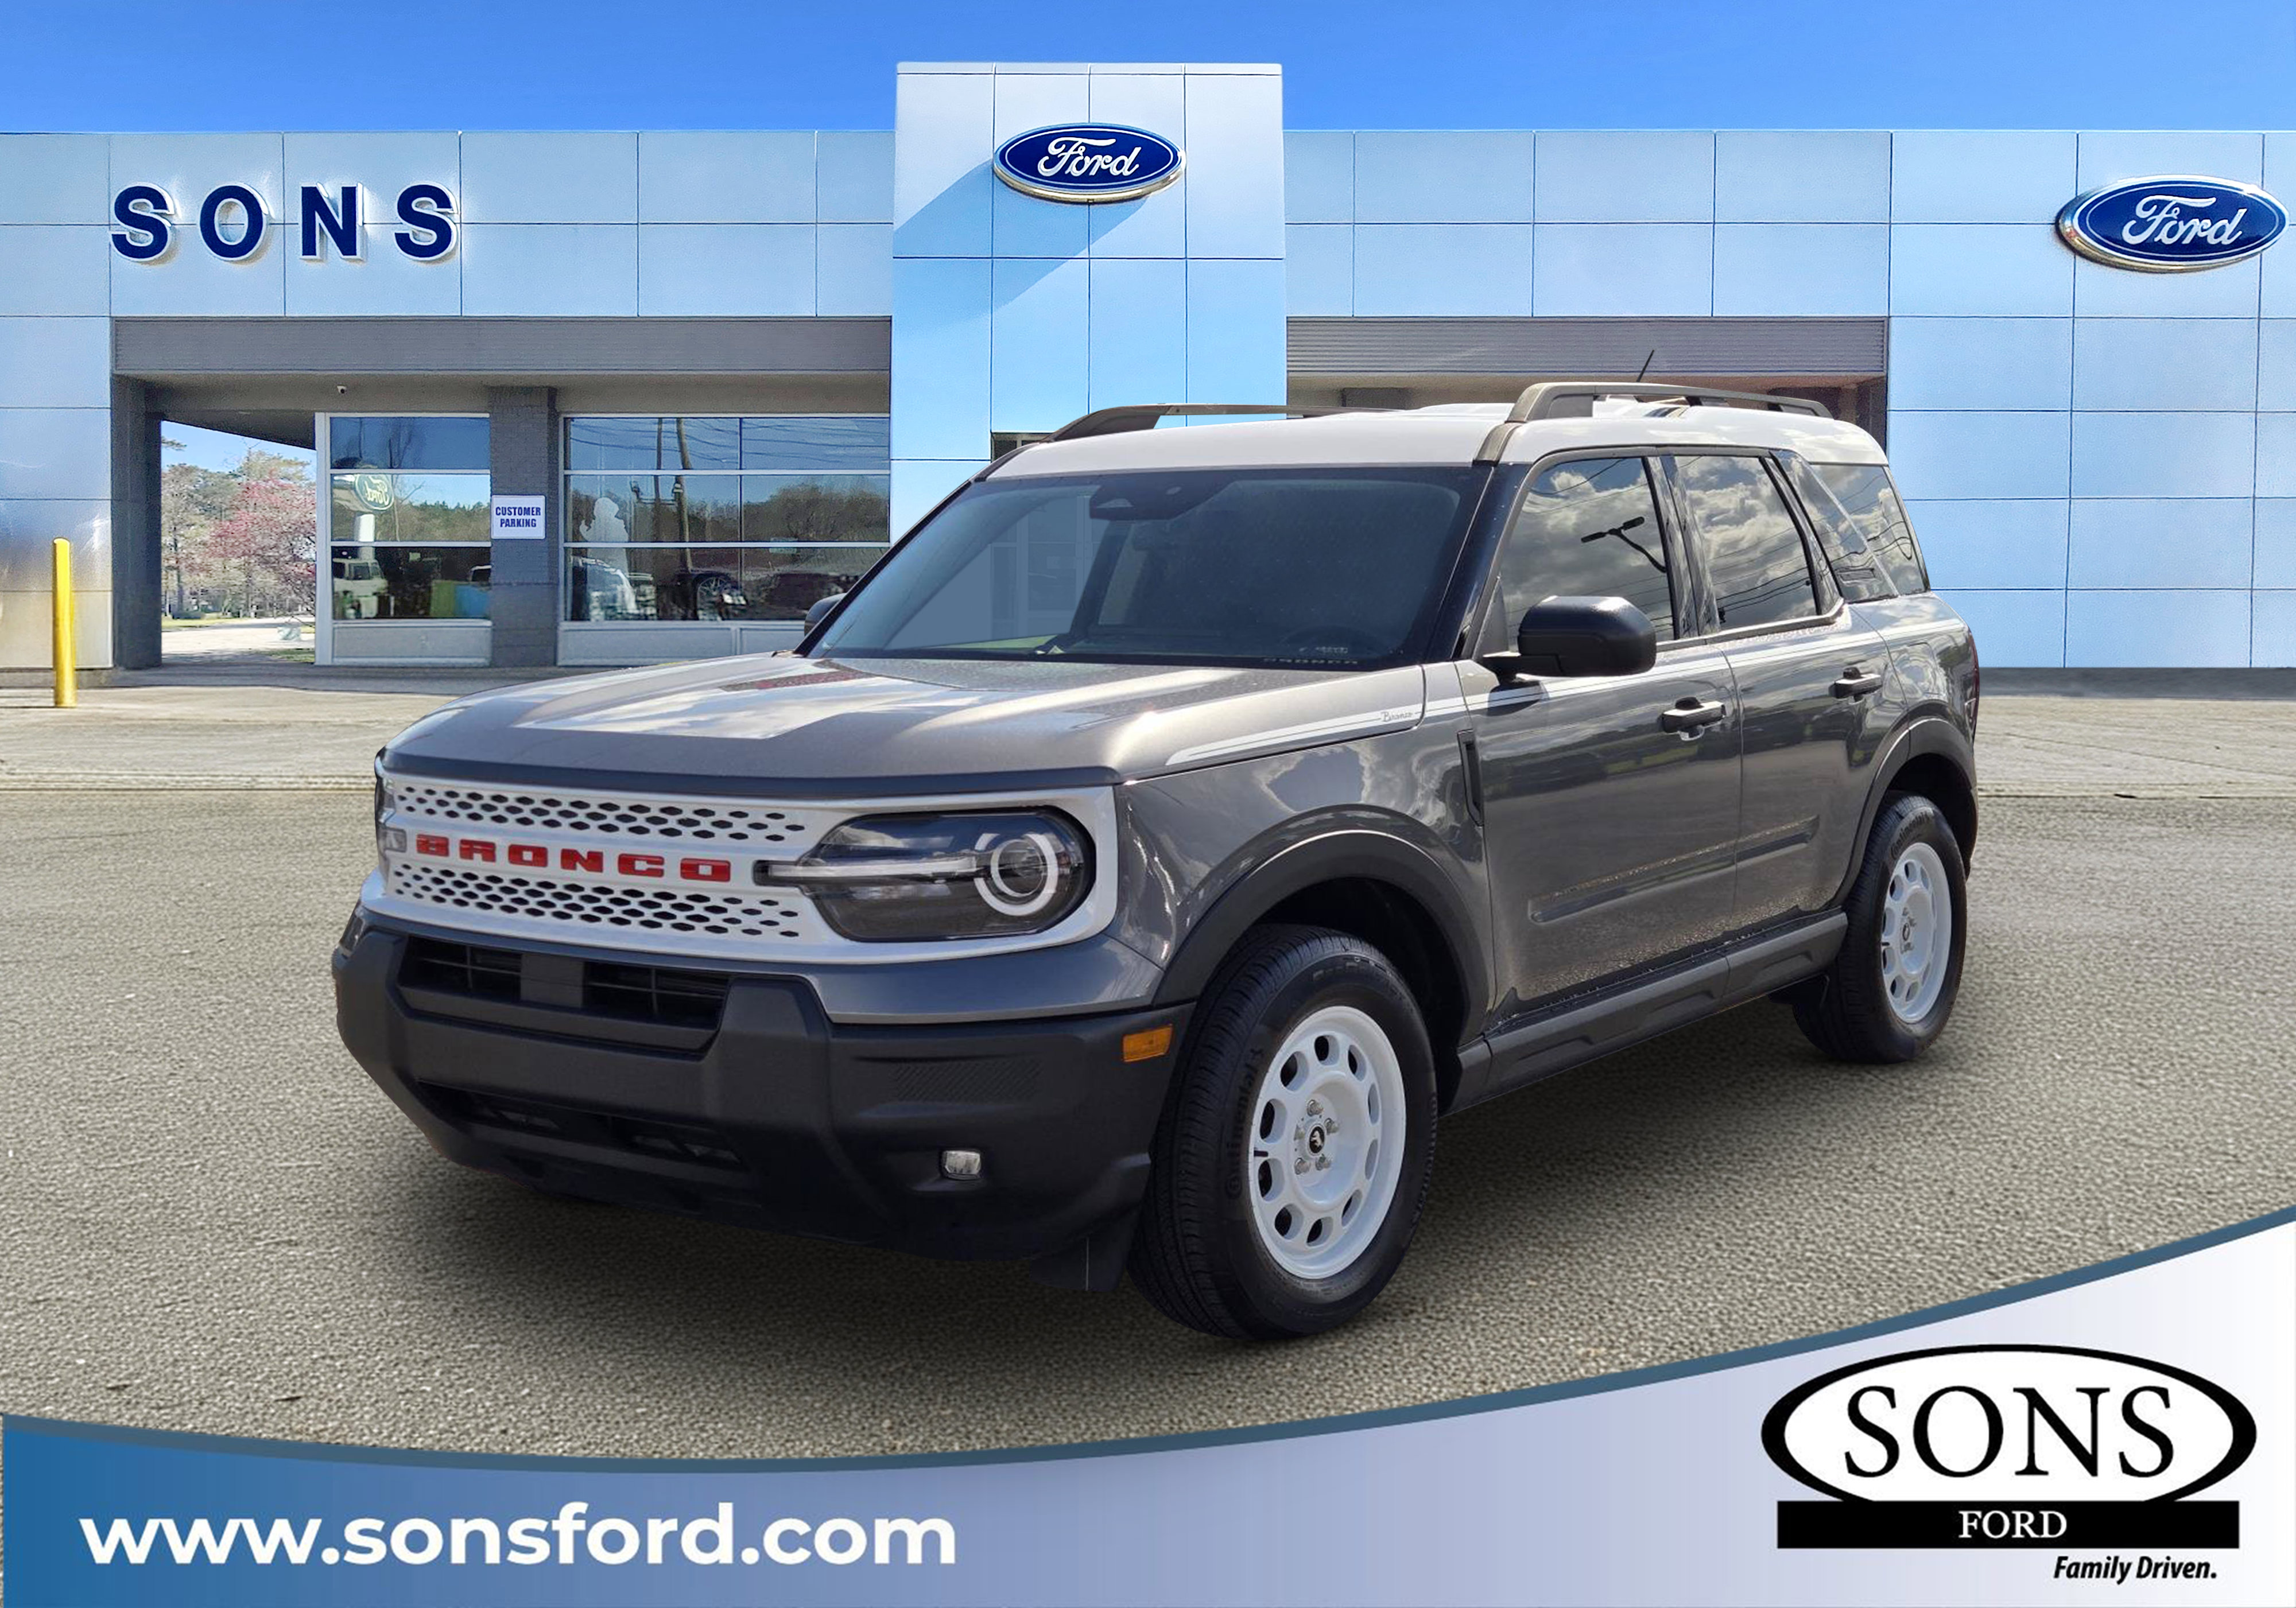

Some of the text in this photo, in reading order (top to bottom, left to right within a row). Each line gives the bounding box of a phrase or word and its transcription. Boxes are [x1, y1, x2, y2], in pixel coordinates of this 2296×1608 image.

[1038, 137, 1142, 177] Ford
[111, 181, 459, 262] SONS
[2122, 195, 2247, 245] Ford
[495, 507, 541, 516] CUSTOMER
[500, 518, 536, 527] PARKING
[416, 833, 731, 883] BRONCO
